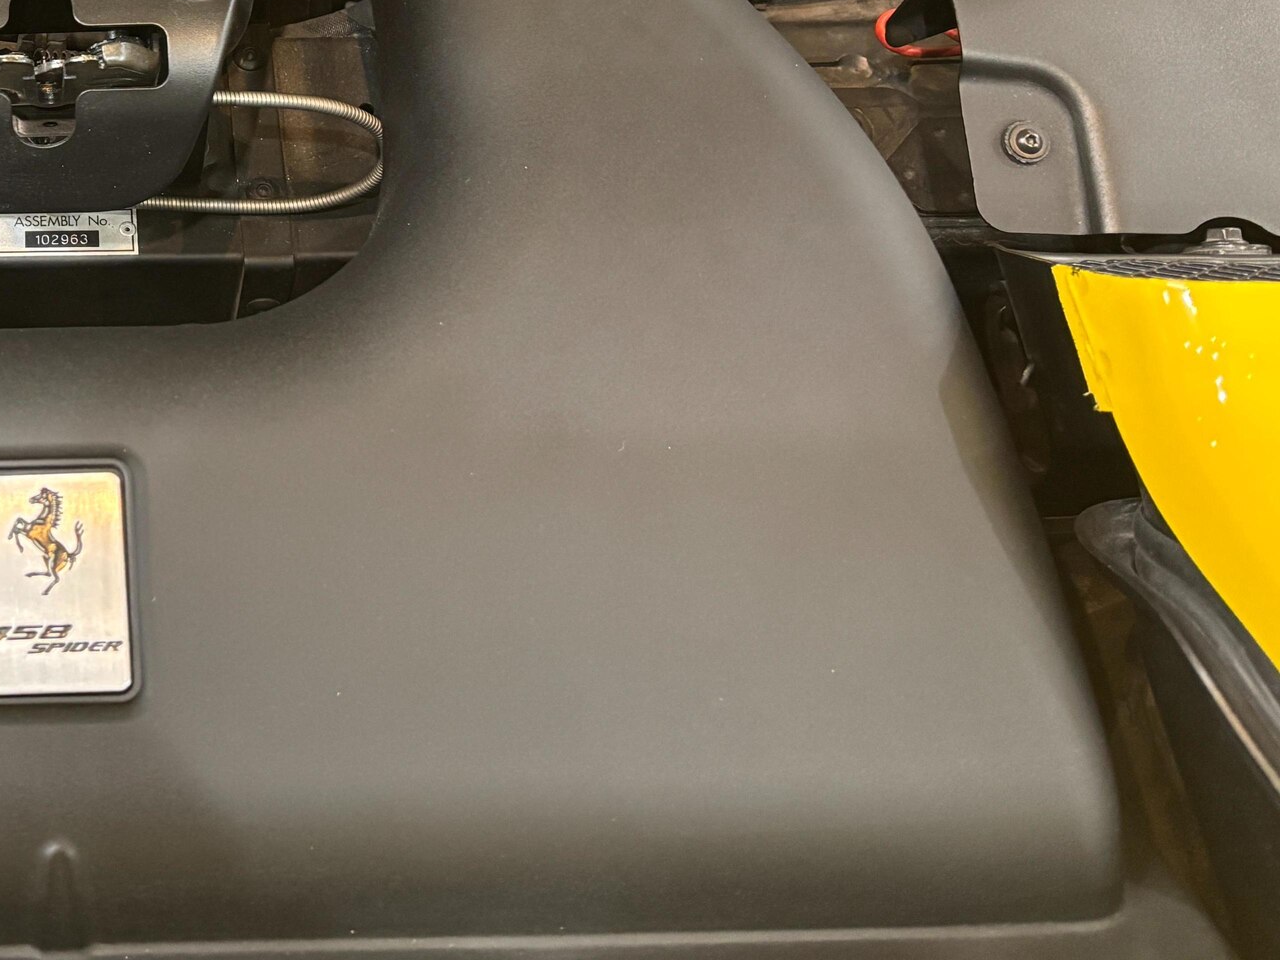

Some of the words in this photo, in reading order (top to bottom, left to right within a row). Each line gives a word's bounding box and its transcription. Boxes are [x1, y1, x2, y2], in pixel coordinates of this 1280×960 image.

[14, 215, 81, 227] ASSEMBLY
[36, 234, 89, 245] 102963
[27, 640, 123, 655] SPIDER
